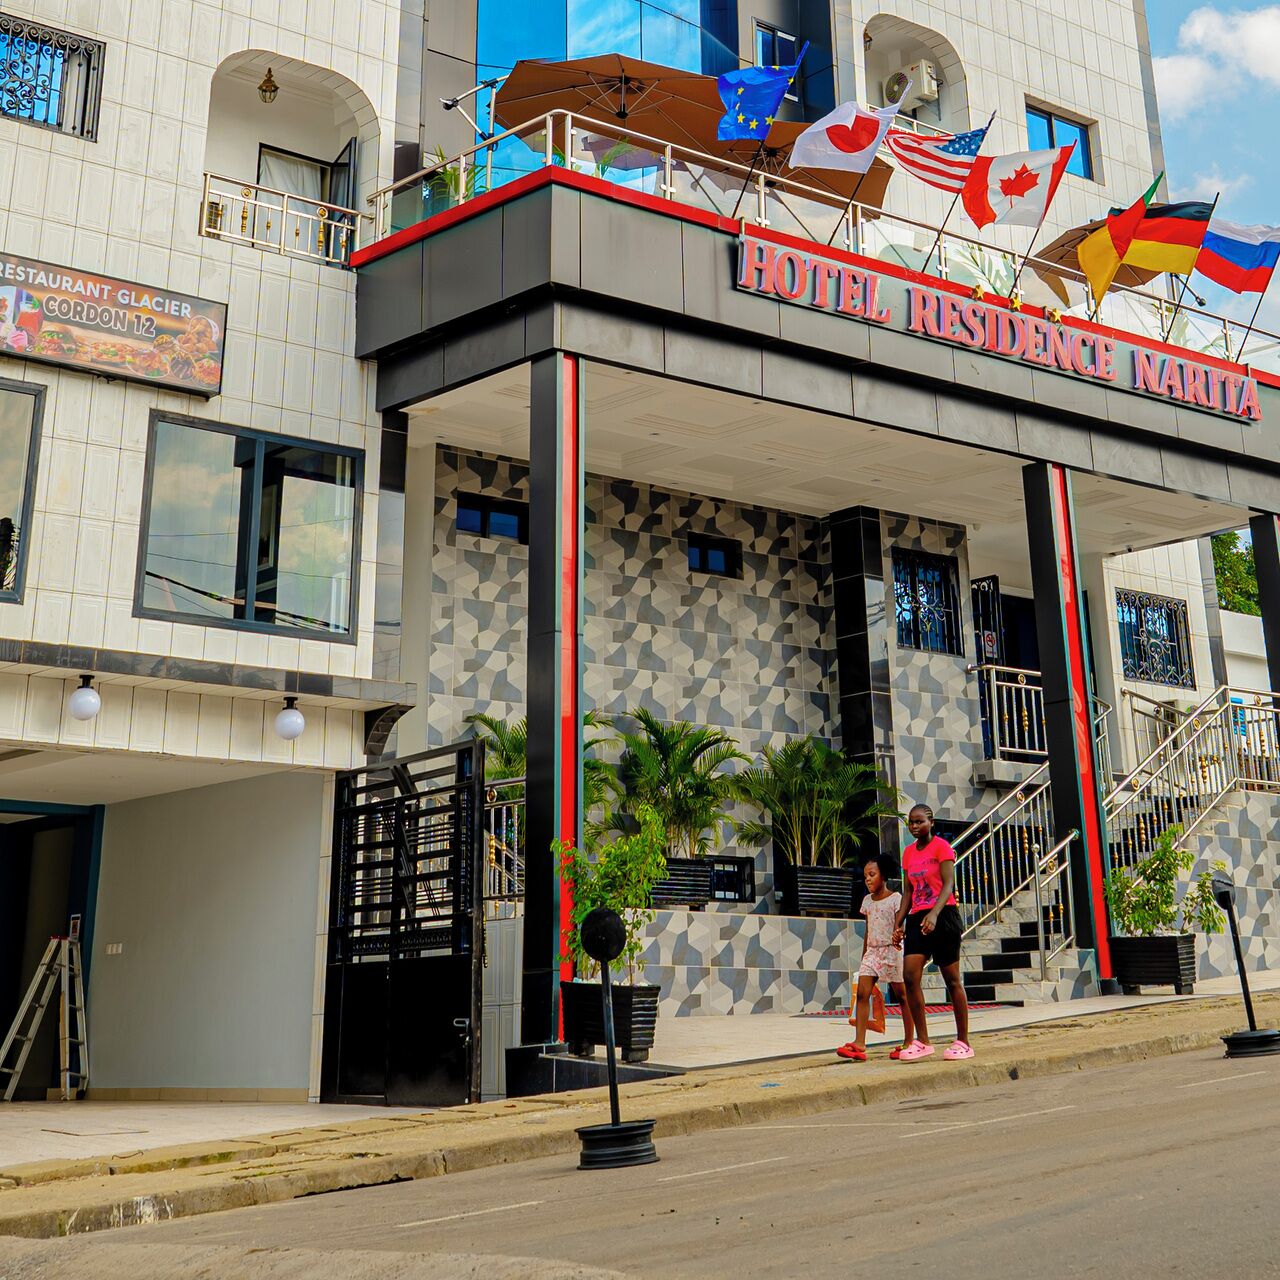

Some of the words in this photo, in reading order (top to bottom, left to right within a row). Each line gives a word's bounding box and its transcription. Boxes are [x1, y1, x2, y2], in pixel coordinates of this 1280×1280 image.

[42, 294, 129, 332] CORDON
[133, 314, 156, 338] 12
[737, 236, 891, 323] HOTEL
[908, 285, 1117, 381] RESIDENCE
[1133, 348, 1263, 421] NARITA
